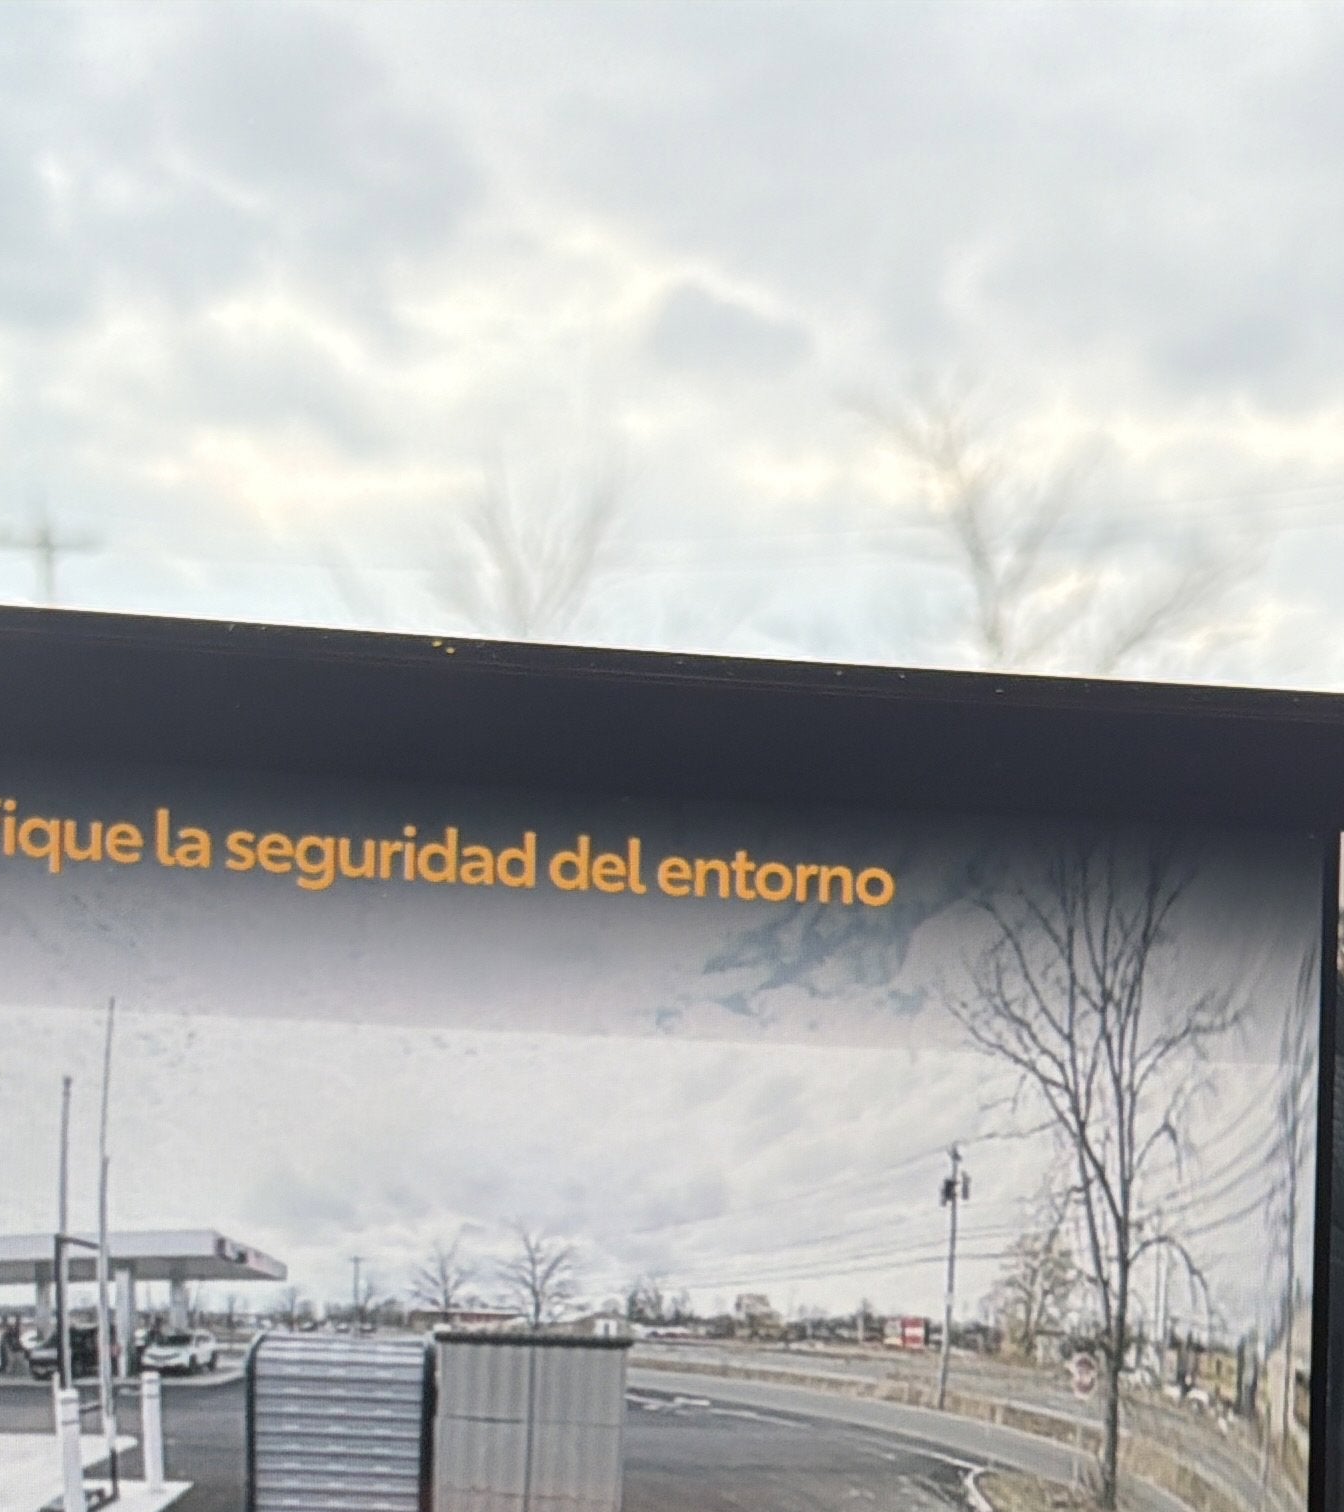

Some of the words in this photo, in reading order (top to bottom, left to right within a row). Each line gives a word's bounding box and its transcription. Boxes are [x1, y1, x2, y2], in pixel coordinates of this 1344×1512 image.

[155, 810, 213, 868] la
[225, 825, 537, 891] seguridad
[548, 835, 646, 896] del
[657, 849, 894, 906] entorno
